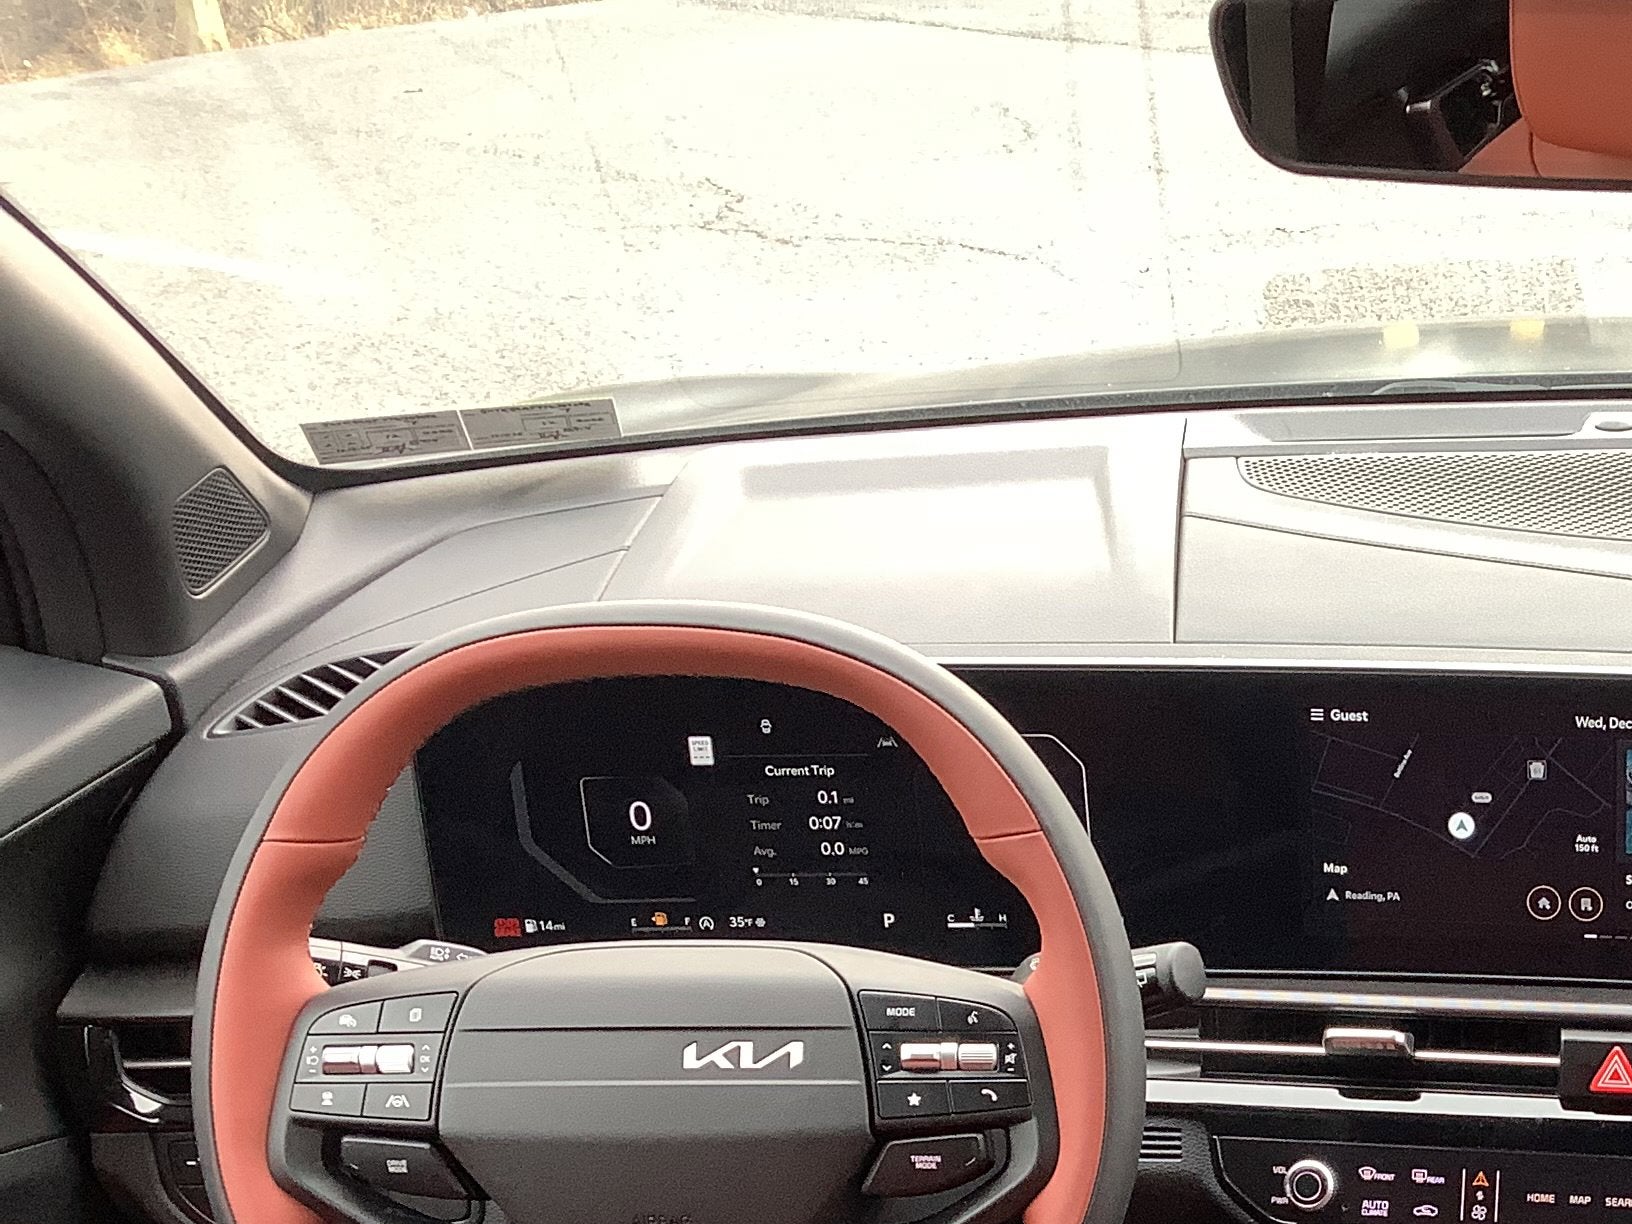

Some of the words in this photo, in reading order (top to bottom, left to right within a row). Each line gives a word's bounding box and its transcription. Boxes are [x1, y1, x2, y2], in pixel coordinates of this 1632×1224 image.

[1330, 709, 1368, 722] Guest
[1575, 716, 1607, 731] Wed,
[765, 765, 809, 776] Current
[811, 765, 835, 778] Trip
[747, 795, 770, 806] Trip
[817, 791, 838, 804] 0.1
[629, 801, 652, 831] 0
[750, 820, 782, 830] Timer
[808, 816, 841, 830] 0:07
[631, 836, 656, 845] MPH
[1576, 834, 1597, 843] Auto
[753, 846, 777, 858] Avg.
[820, 842, 845, 856] 0.0
[849, 847, 868, 855] MPG
[1574, 844, 1590, 853] 150
[1591, 844, 1599, 853] ft
[1323, 862, 1348, 875] Map
[755, 878, 763, 886] 0
[789, 878, 799, 886] 15
[826, 877, 836, 886] 30
[858, 877, 869, 885] 45
[1345, 891, 1386, 902] Reading,
[1387, 892, 1400, 901] PA
[631, 918, 637, 927] E
[685, 917, 690, 926] F
[883, 913, 895, 928] P
[947, 914, 955, 922] C
[998, 914, 1007, 922] H
[886, 1008, 916, 1017] MODE
[682, 1041, 804, 1069] KIA
[1273, 1166, 1288, 1175] VOL
[1374, 1173, 1396, 1182] FRONT
[1427, 1175, 1445, 1184] REAR
[1271, 1196, 1289, 1205] PWR
[1527, 1193, 1555, 1204] HOME
[1569, 1195, 1591, 1205] MAP
[1362, 1200, 1389, 1210] AUTO
